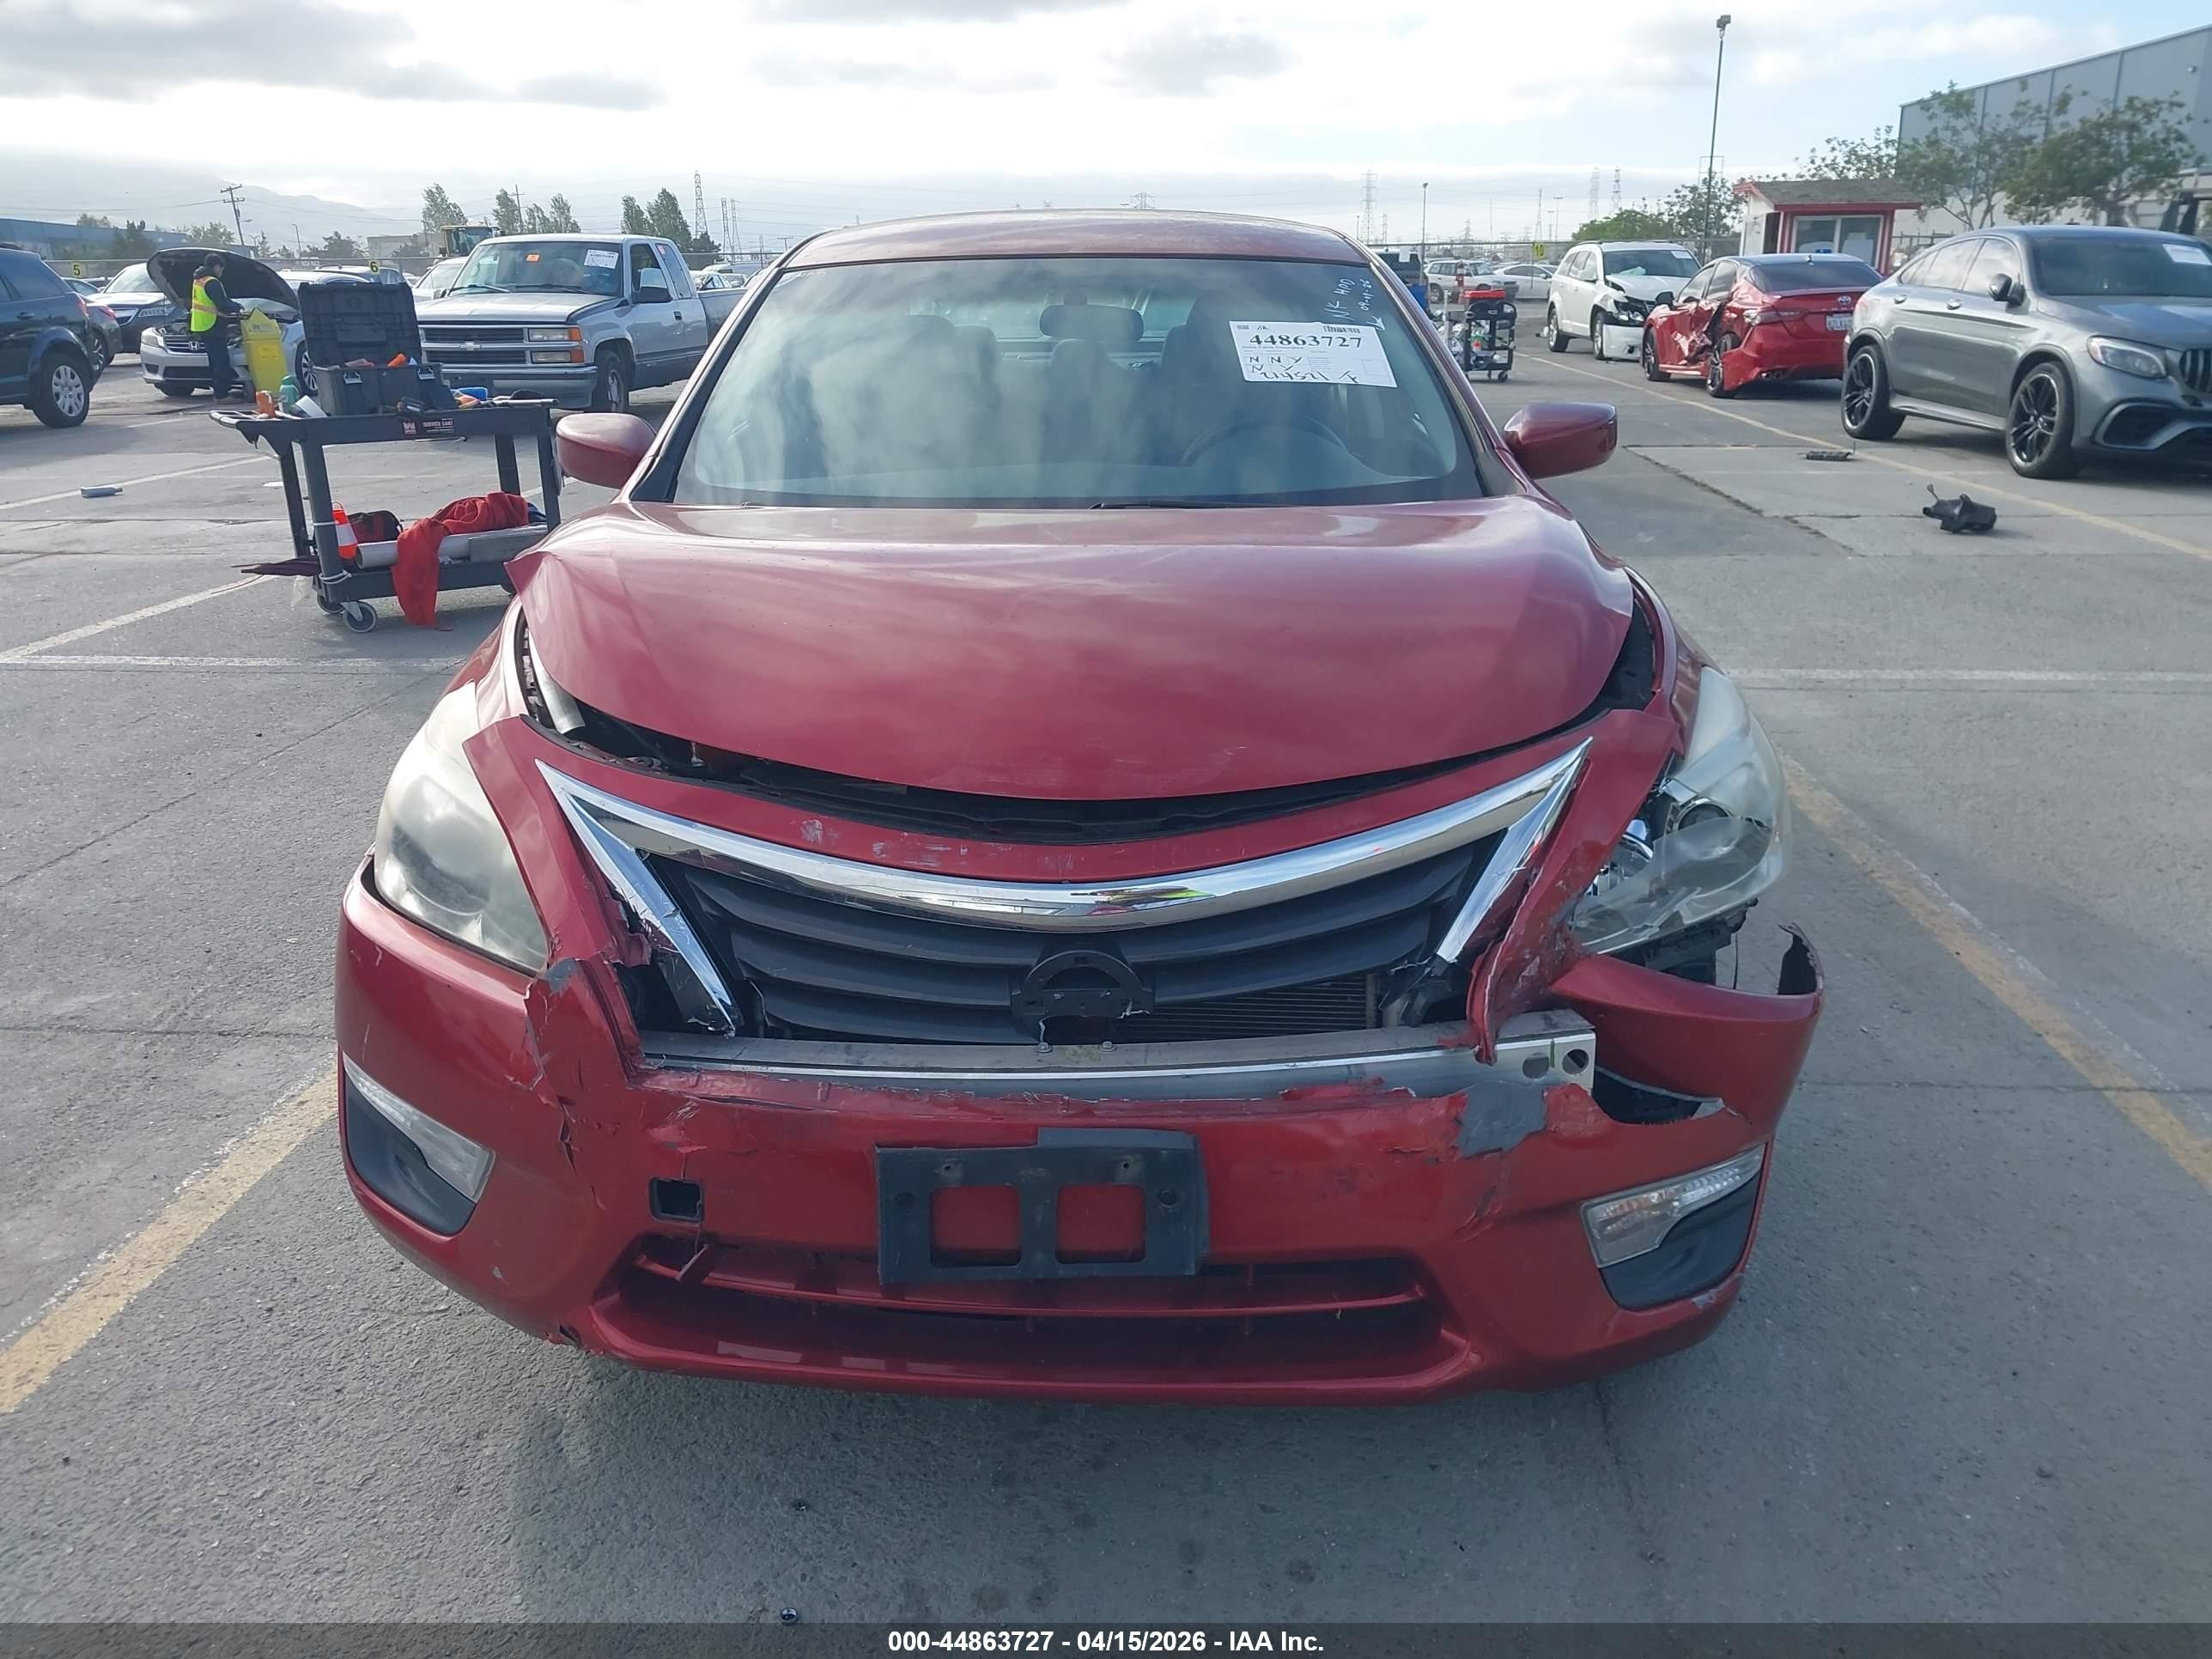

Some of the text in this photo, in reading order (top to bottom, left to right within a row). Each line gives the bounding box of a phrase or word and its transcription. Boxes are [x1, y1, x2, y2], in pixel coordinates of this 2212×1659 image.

[1535, 244, 1545, 257] 10
[73, 264, 81, 276] 5
[370, 261, 379, 273] 6
[1249, 333, 1363, 349] 44863727
